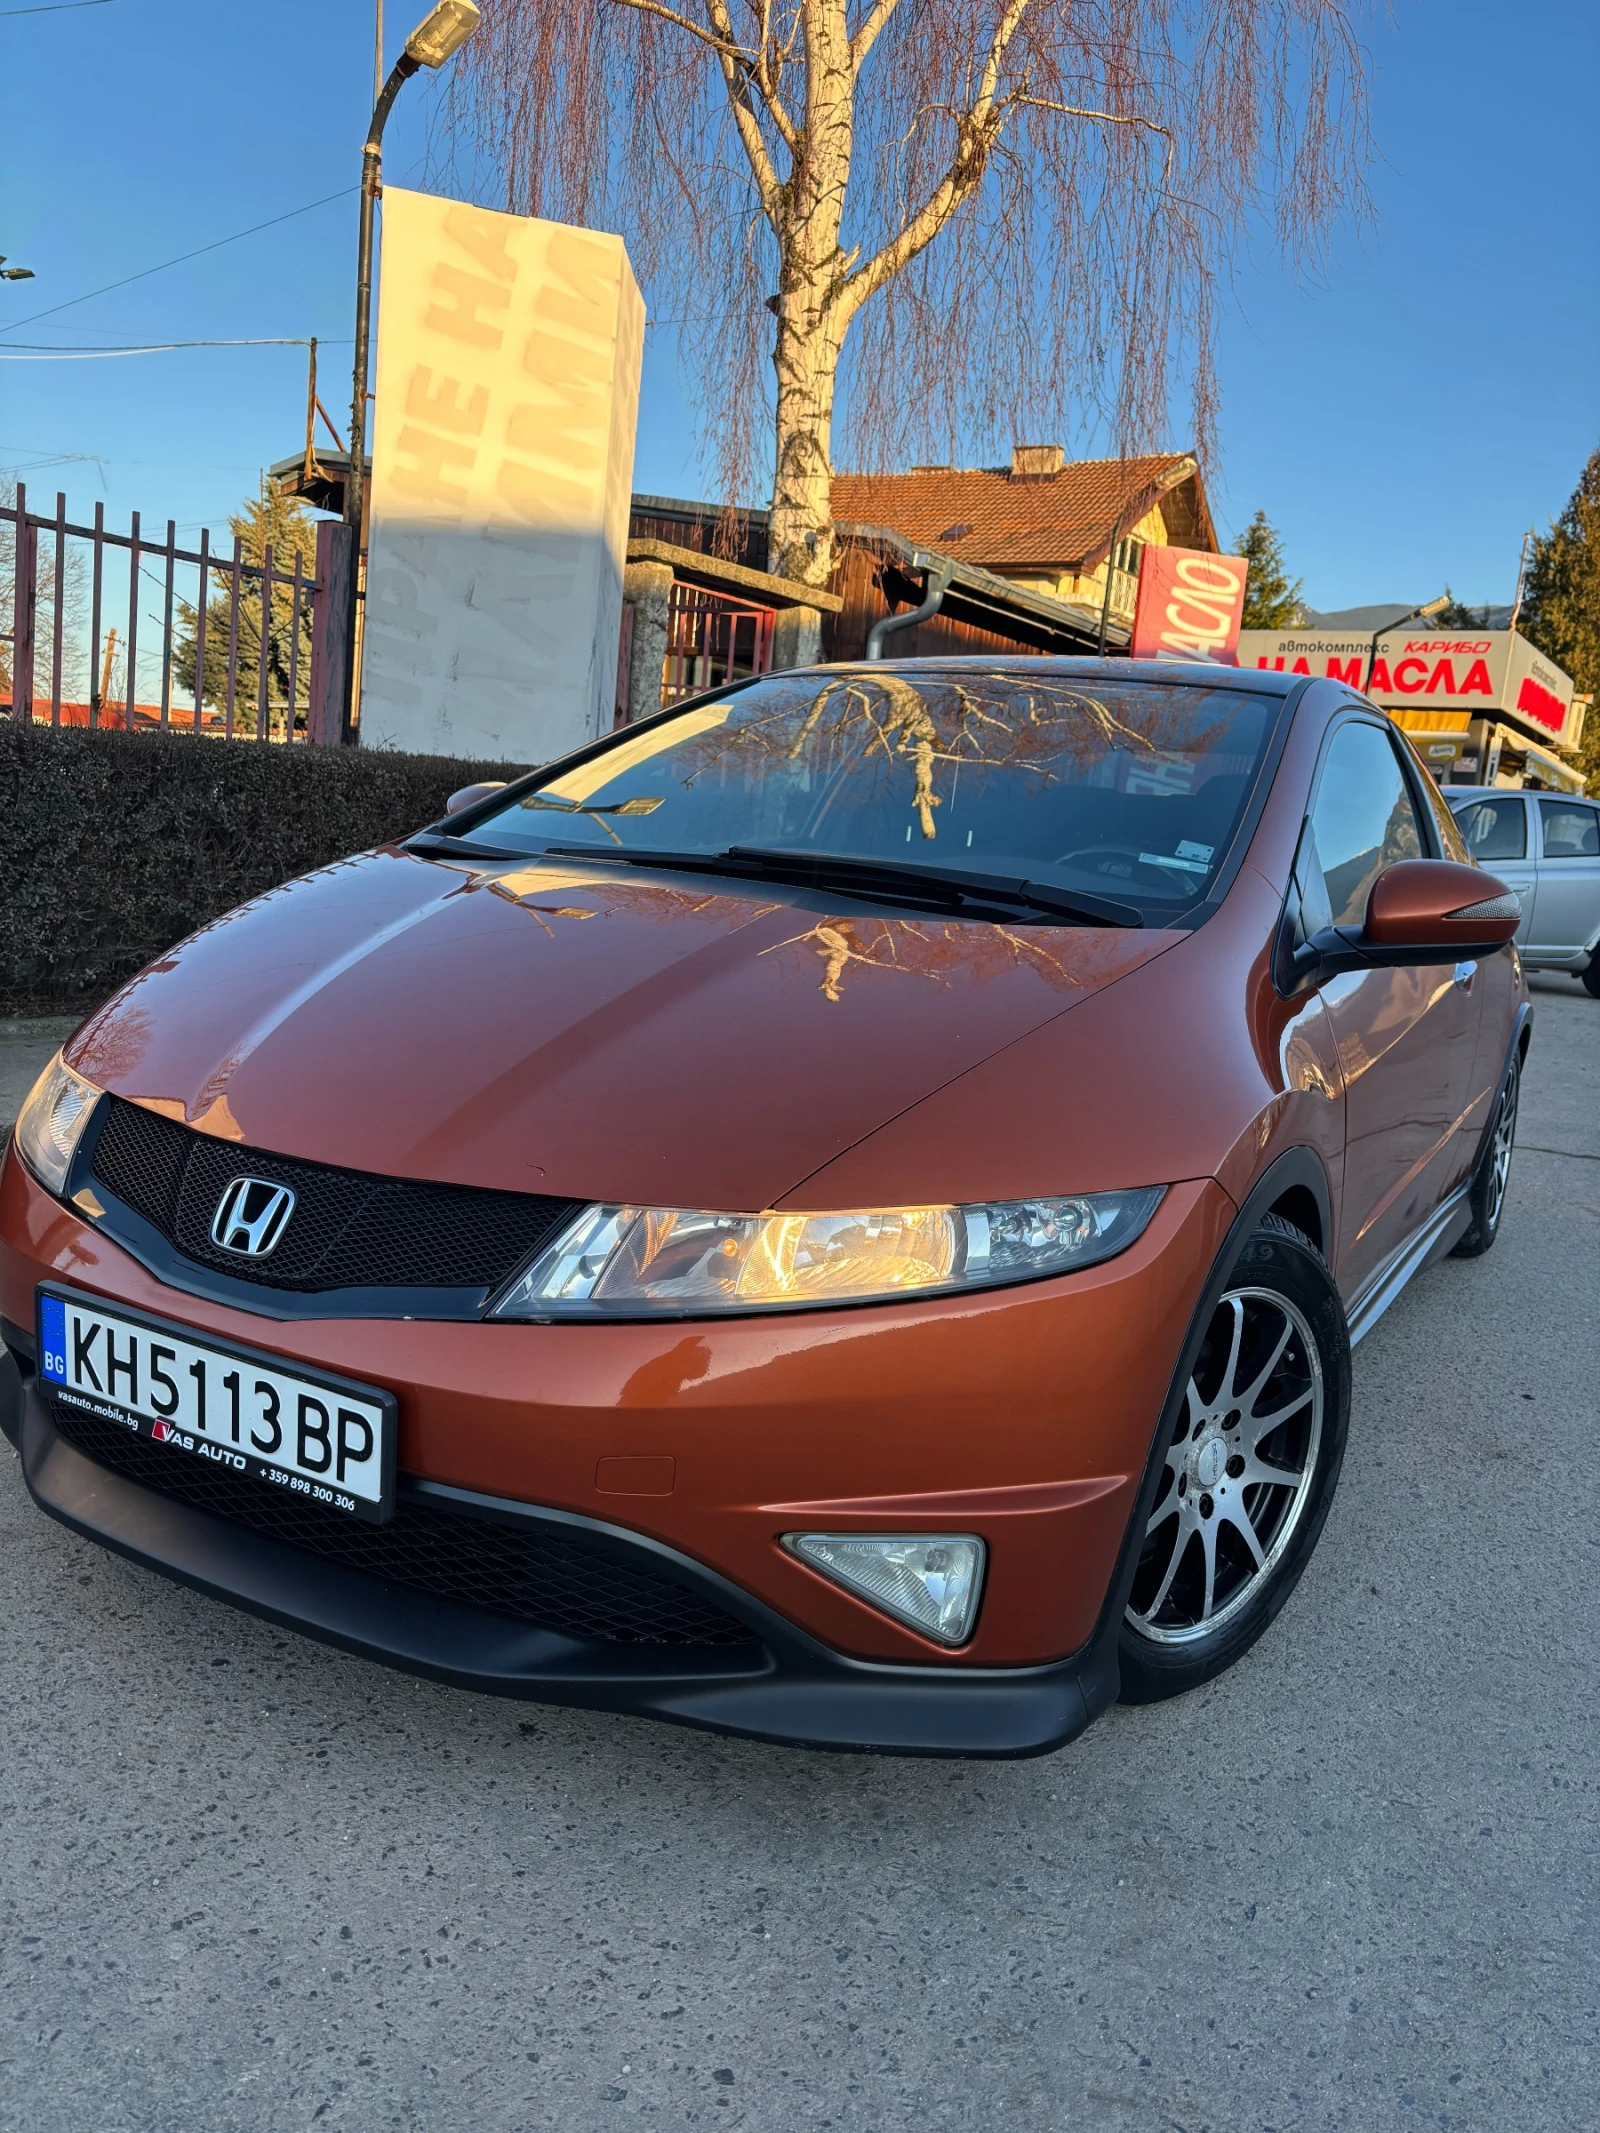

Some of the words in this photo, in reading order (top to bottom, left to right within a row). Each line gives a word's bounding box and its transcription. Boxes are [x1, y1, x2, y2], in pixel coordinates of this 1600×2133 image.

[1156, 558, 1241, 663] АСЛО
[1403, 641, 1492, 654] КАРИБО
[1326, 657, 1494, 695] МАСЛА
[45, 1351, 64, 1374] BG
[58, 1390, 139, 1431] vasauto.mobile.bg
[73, 1316, 374, 1483] KH5113BP
[161, 1425, 195, 1450] VAS
[198, 1443, 246, 1470] AUTO
[268, 1468, 289, 1485] 359
[290, 1477, 310, 1493] 898
[312, 1485, 333, 1502] 300
[334, 1494, 355, 1511] 306
